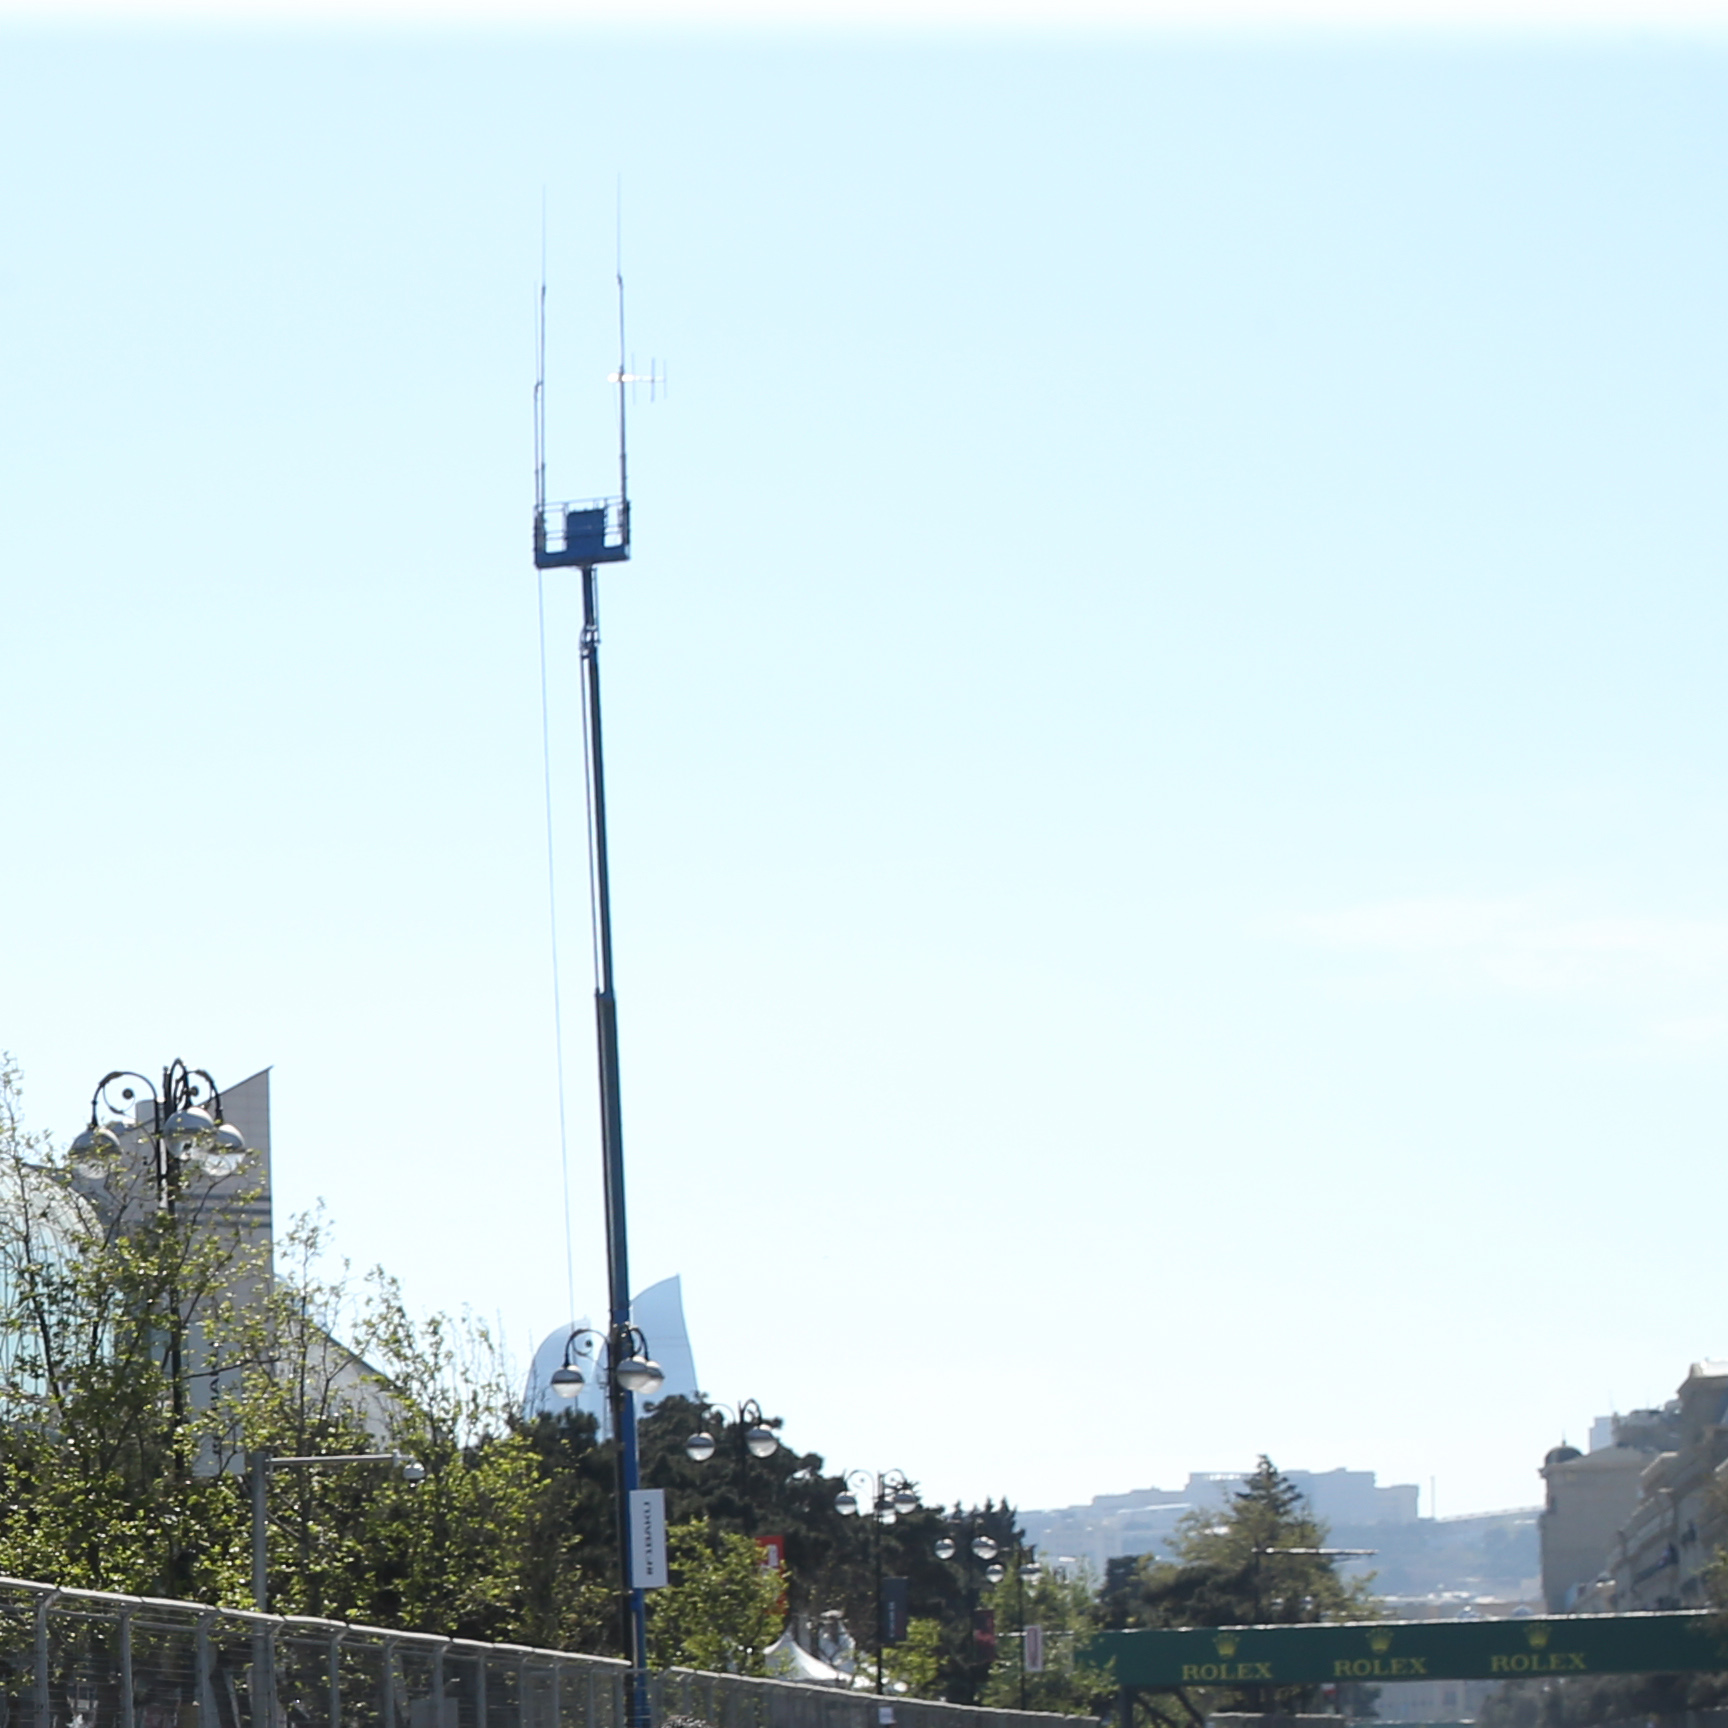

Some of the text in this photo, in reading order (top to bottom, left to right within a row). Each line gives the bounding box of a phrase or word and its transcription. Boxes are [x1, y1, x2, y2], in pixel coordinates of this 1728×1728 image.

[1182, 1662, 1274, 1681] ROLEX
[1332, 1656, 1428, 1677] ROLEX
[1490, 1652, 1588, 1672] ROLEX
